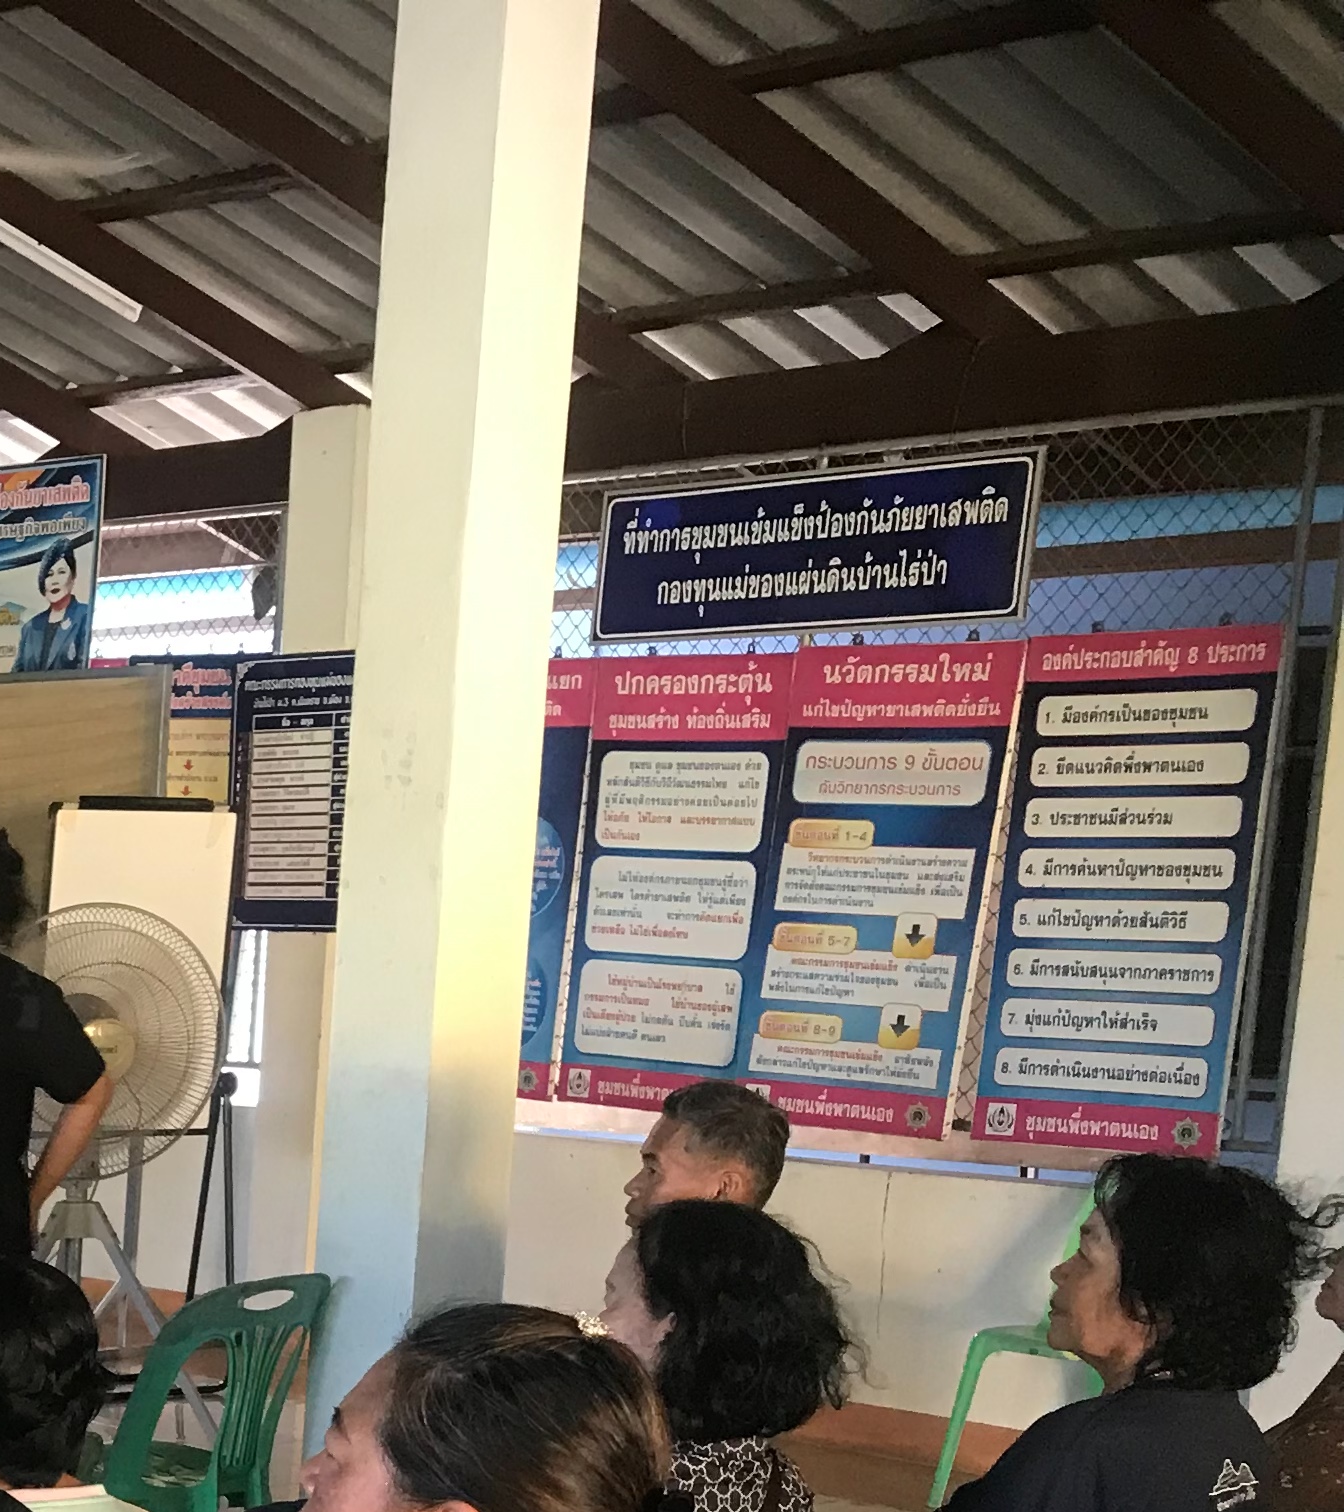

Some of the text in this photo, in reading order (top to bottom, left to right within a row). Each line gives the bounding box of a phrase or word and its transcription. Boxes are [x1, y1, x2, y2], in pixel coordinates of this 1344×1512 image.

[623, 486, 1009, 564] ที่ทำการชุมชนเข้มแข็งป้องกันภัยยาเสพติด
[657, 549, 948, 617] กองทุนแม่ของแผ่นดินบ้านไร่ป่า
[823, 653, 993, 684] นวัตกรรมใหม่
[1042, 640, 1267, 672] องค์ประกอบสำคัญ 8 ประการ
[614, 661, 773, 706] ปกครองกระตุ้น
[609, 701, 771, 736] ชุมชนสร้าง ท้องถิ่นเสริม
[802, 693, 1001, 721] แก้ไขปัญหายาเสพติดยั่งยืน
[1045, 703, 1209, 727] 1. มีองค์กรเป็นของชุมชน
[805, 748, 984, 771] กระบวนการ 9 ขั้นตอน
[1038, 751, 1205, 775] 2. ยึดแนวคิดพึ่งพาตนเอง
[1031, 807, 1174, 826] 3. ประชาชนมีส่วนร่วม
[1025, 858, 1223, 884] 4. มีการค้นหาปัญหาของชุมชน
[1019, 908, 1188, 931] 5. แก้ไขปัญหาด้วยสันติวิธี
[1013, 958, 1214, 986] 6. มีการสนับสนุนจากภาคราชการ
[1008, 1008, 1158, 1032] 7. มุ่งแก้ปัญหาให้สำเร็จ
[1001, 1058, 1200, 1086] 8. มีการดำเนินงานอย่างต่อเนื่อง
[597, 1073, 678, 1101] ชุมชนพึ่งพาต
[777, 1090, 894, 1123] ชมชนพึ่งพาตนเอง
[1025, 1107, 1159, 1140] ชุมชนพึ่งพาตนเอง
